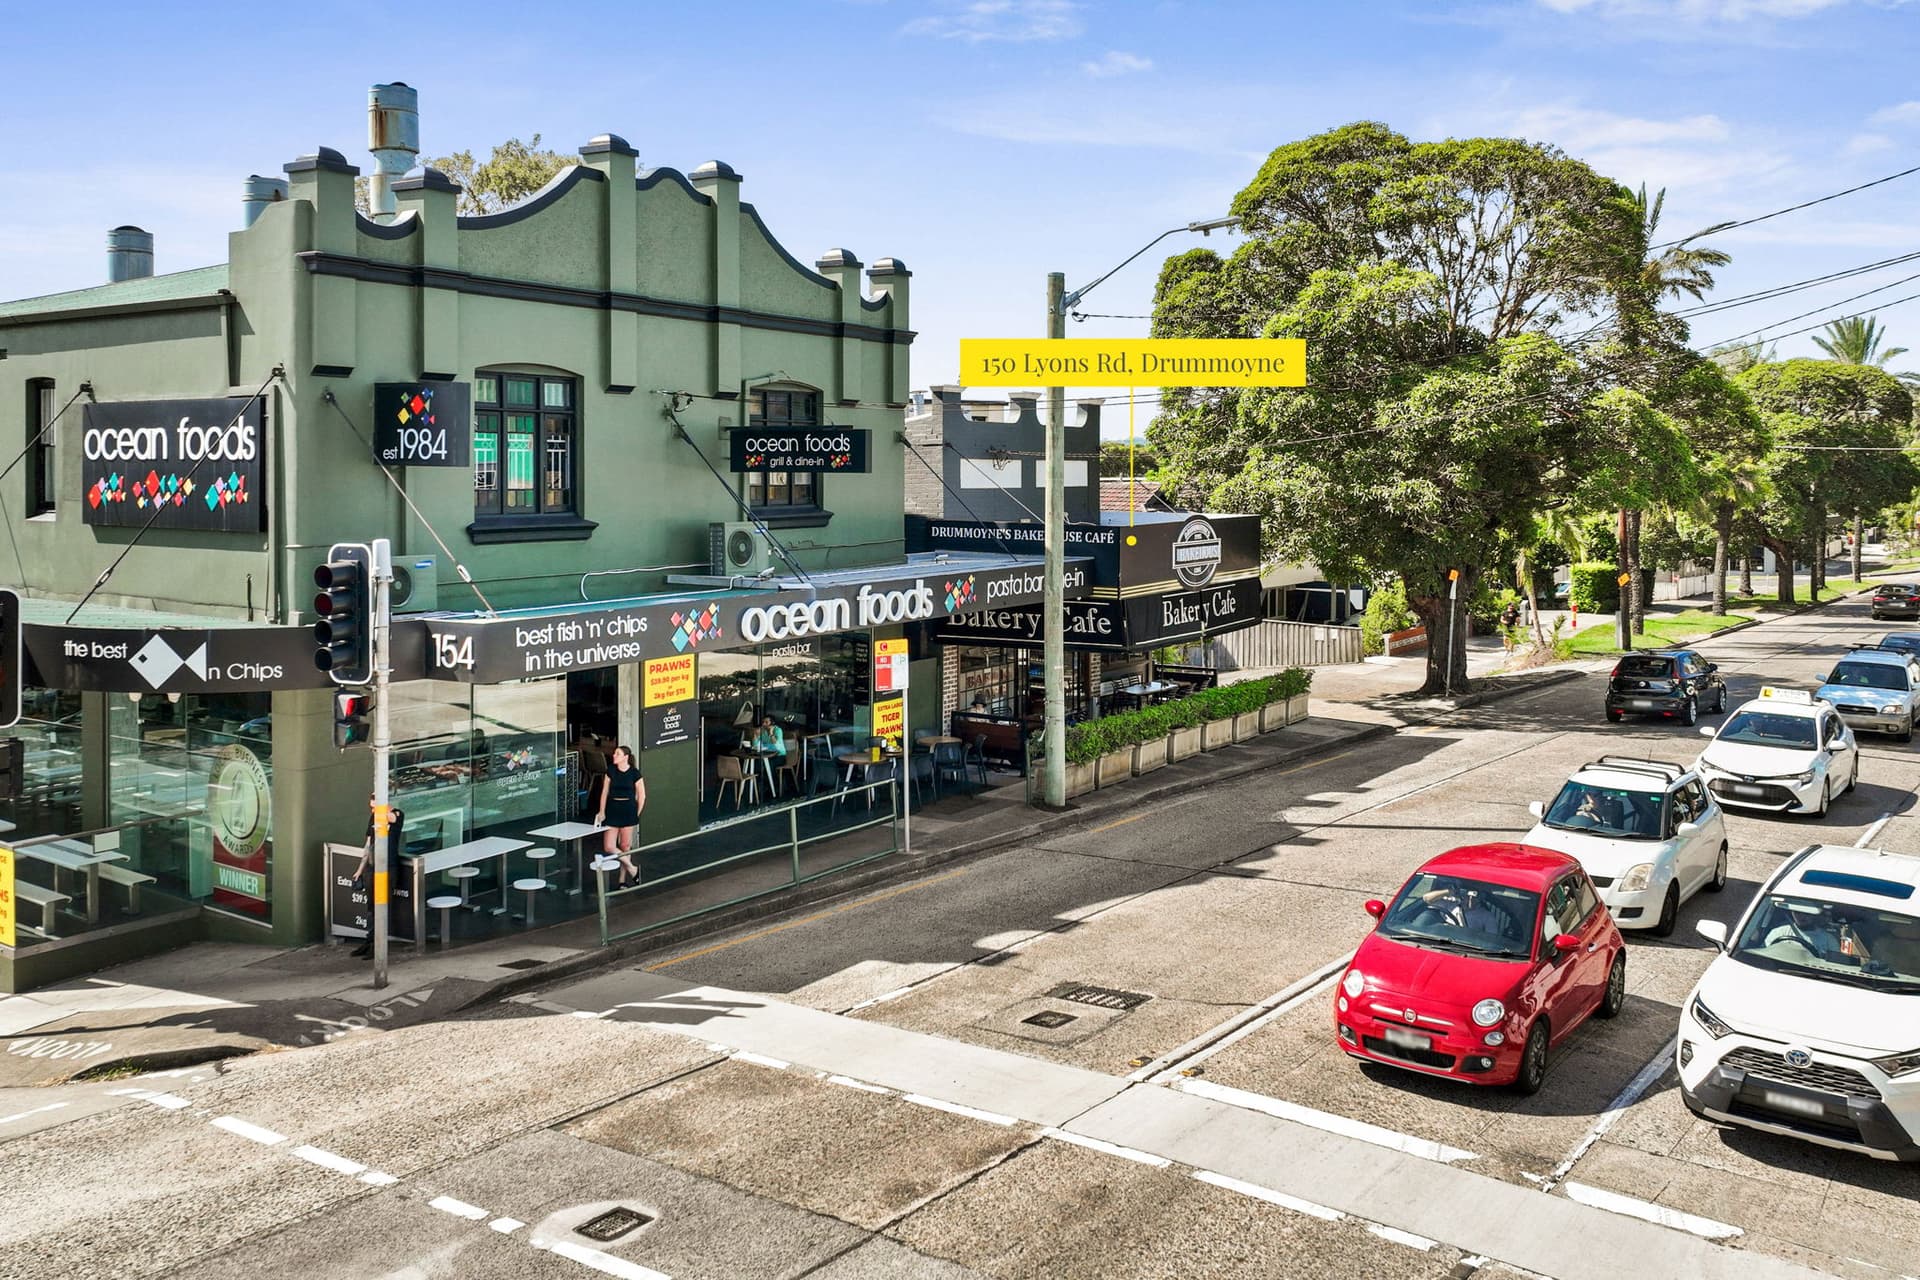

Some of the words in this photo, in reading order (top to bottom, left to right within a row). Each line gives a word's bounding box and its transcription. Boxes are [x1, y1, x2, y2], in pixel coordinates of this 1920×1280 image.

[84, 427, 168, 460] ocean
[177, 415, 256, 460] foods
[383, 446, 398, 460] est
[397, 428, 447, 460] 1984
[745, 437, 799, 452] ocean
[805, 433, 851, 452] foods
[769, 456, 785, 468] grill
[786, 457, 793, 466] &
[795, 456, 825, 466] dine-in
[931, 526, 1011, 539] DRUMMOYNE'S
[1085, 530, 1114, 544] CAFÉ
[986, 573, 1022, 604] pasta
[1024, 572, 1044, 592] bar
[741, 598, 850, 642] ocean
[857, 579, 934, 626] foods
[1212, 589, 1237, 617] Cafe
[515, 623, 554, 648] best
[556, 620, 583, 642] fish
[607, 614, 648, 637] chips
[64, 640, 88, 658] the
[91, 641, 128, 659] best
[431, 632, 475, 671] 154
[525, 651, 541, 672] in
[544, 648, 573, 669] the
[577, 642, 640, 664] universe
[772, 643, 796, 658] pasta
[797, 642, 811, 654] bar
[208, 666, 220, 679] n
[226, 663, 283, 682] Chips
[649, 659, 691, 674] PRAWNS
[1764, 689, 1771, 697] L
[881, 712, 900, 723] TIGER
[223, 836, 254, 854] AWARDS
[219, 867, 259, 895] WINNER
[337, 875, 353, 887] Extra
